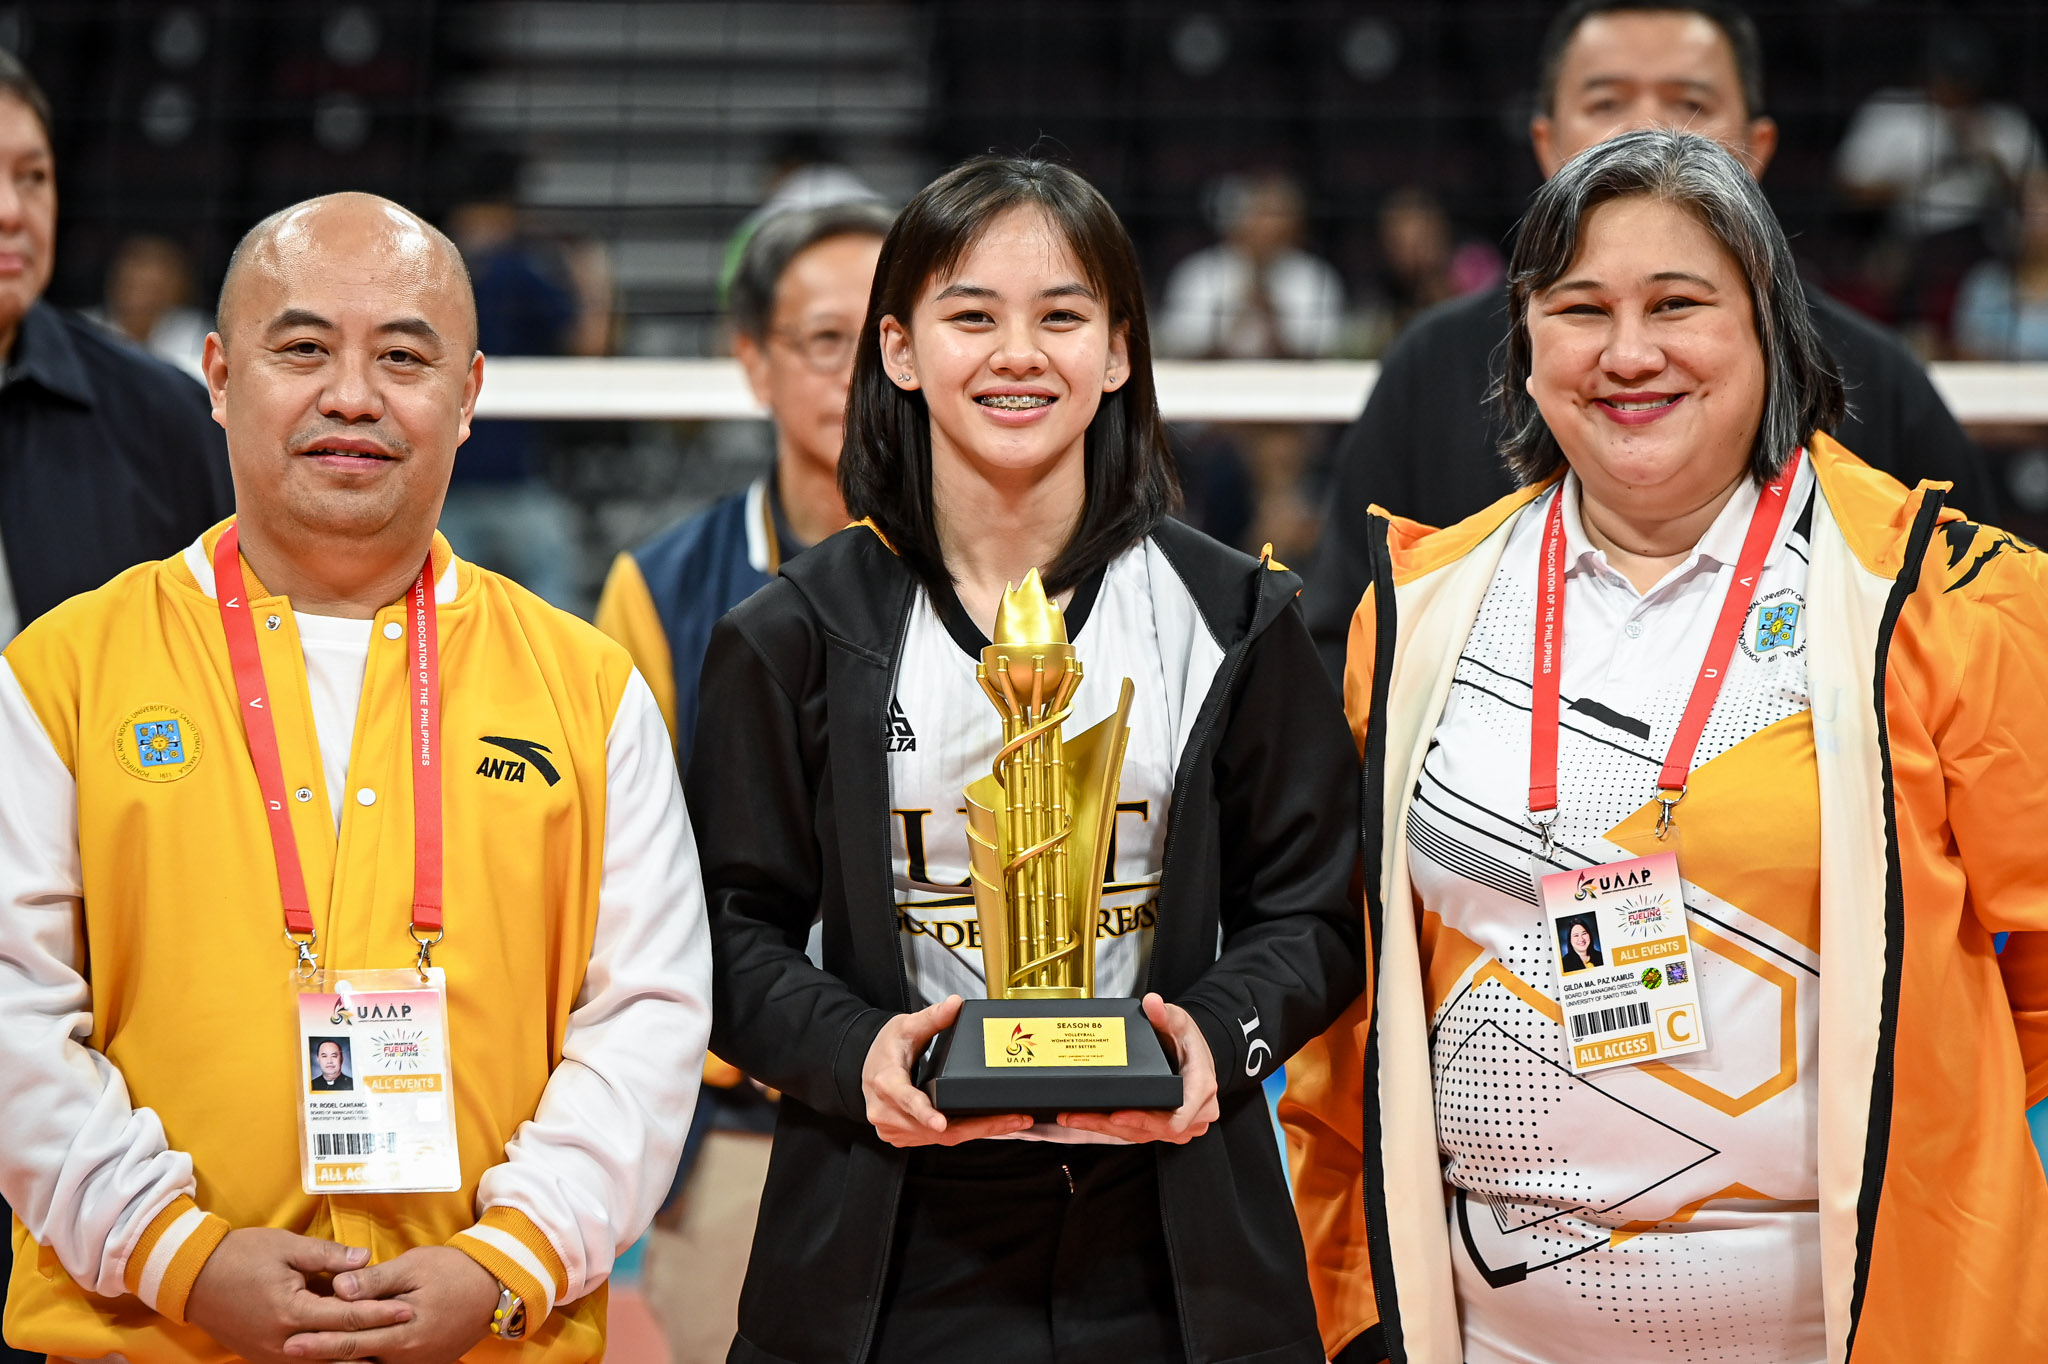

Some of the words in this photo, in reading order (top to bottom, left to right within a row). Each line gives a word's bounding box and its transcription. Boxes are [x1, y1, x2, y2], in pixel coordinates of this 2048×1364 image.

[1547, 538, 1558, 593] ASSOCIATION
[1547, 595, 1556, 605] OF
[1545, 606, 1555, 623] THE
[416, 608, 428, 669] ASSOCIATION
[1543, 624, 1554, 674] PHILIPPINES
[419, 671, 428, 685] OF
[420, 687, 429, 706] THE
[130, 705, 168, 719] UNIVERSITY
[117, 718, 133, 737] ROYAL
[179, 713, 197, 732] SANTO
[116, 738, 125, 752] AND
[193, 732, 201, 754] TOMAS
[421, 708, 430, 767] PHILIPPINES
[886, 737, 917, 752] LTA
[476, 757, 526, 783] ANTA
[1599, 868, 1651, 890] UAAP
[1628, 908, 1661, 921] FUELING
[1620, 949, 1640, 961] ALL
[1641, 941, 1680, 957] EVENTS
[1564, 982, 1583, 992] GILDA
[1584, 980, 1596, 988] MA.
[1597, 977, 1610, 985] PAZ
[1611, 972, 1635, 982] KAMUS
[1565, 991, 1582, 1000] BOARD
[1590, 986, 1616, 995] MANAGING
[1566, 997, 1594, 1007] UNIVERSITY
[1603, 992, 1619, 1001] SANTO
[1620, 988, 1638, 997] TOMAS
[357, 1003, 411, 1019] UAAP
[1666, 1010, 1691, 1042] C
[383, 1045, 418, 1053] FUELING
[1237, 1006, 1273, 1077] 16
[1580, 1048, 1602, 1063] ALL
[1604, 1037, 1649, 1055] ACCESS
[371, 1079, 392, 1089] ALL
[393, 1077, 434, 1089] EVENTS
[320, 1167, 344, 1182] ALL
